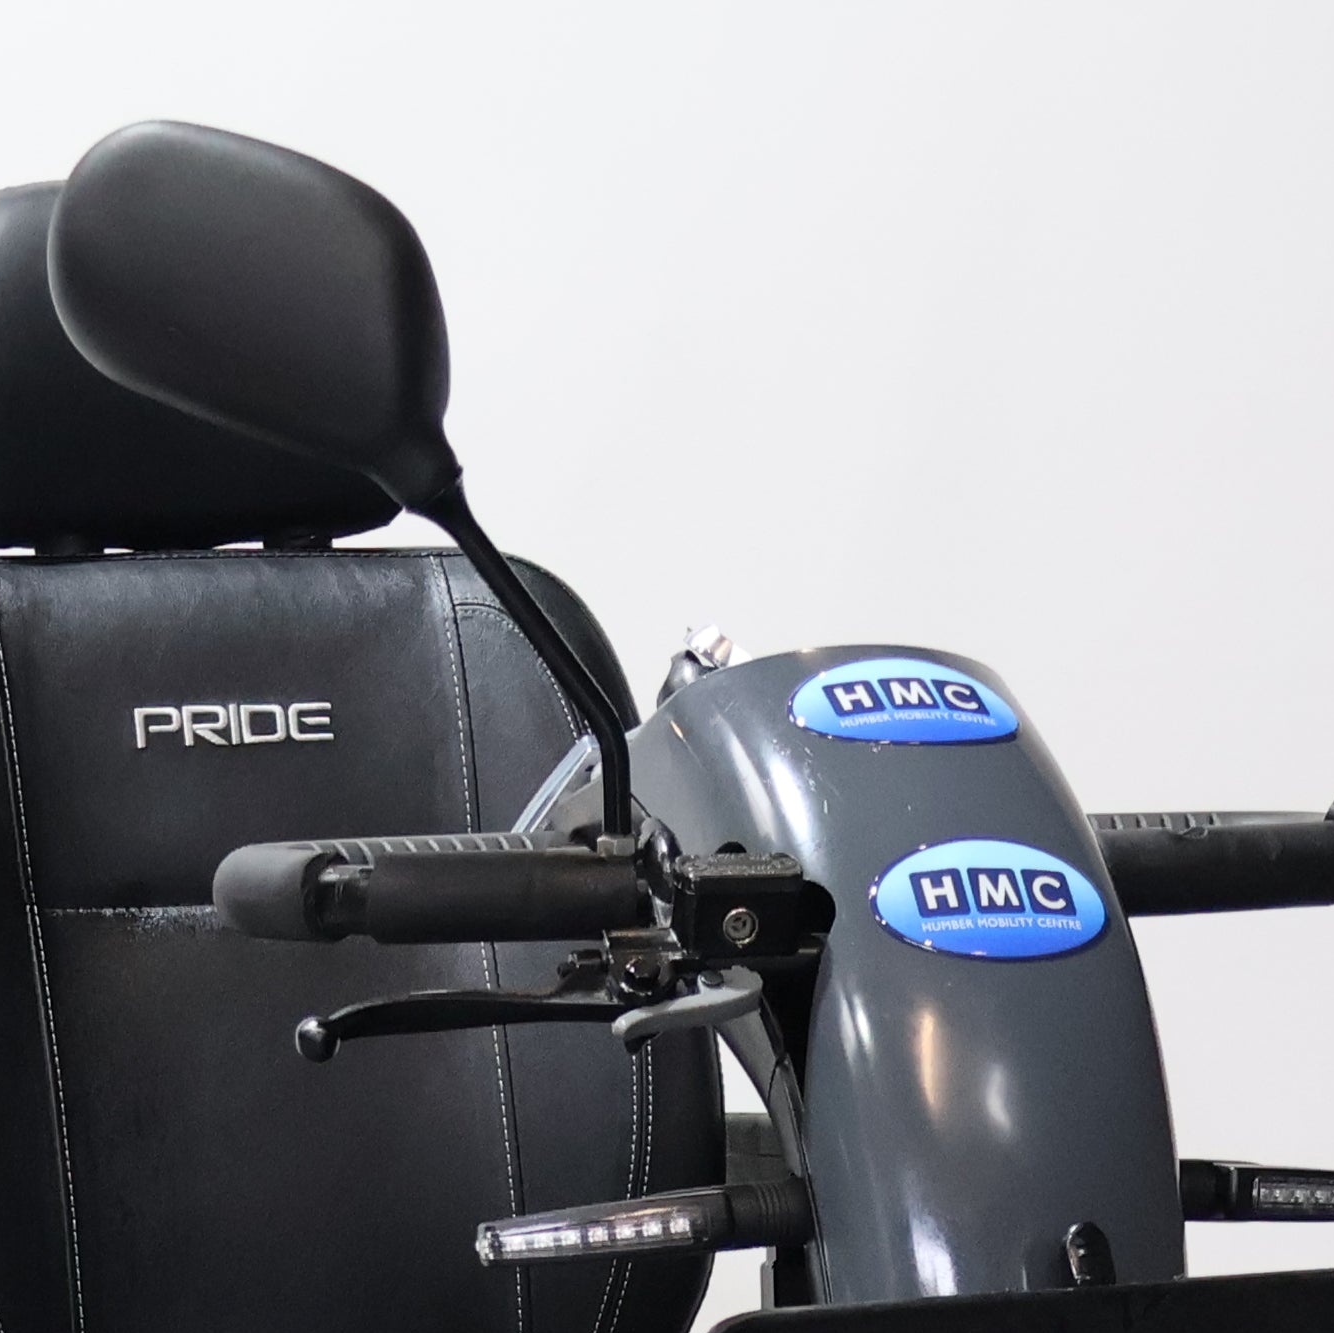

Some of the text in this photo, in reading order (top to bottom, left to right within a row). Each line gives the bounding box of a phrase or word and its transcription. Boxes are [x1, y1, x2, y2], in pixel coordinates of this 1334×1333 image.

[832, 680, 980, 712] HMC
[134, 702, 334, 749] PRIDE
[839, 710, 998, 729] HUMBER MOBILITY CENTRE
[919, 873, 1067, 911] HMC
[921, 916, 1083, 933] HUMBER MOBILITY CENTRE
